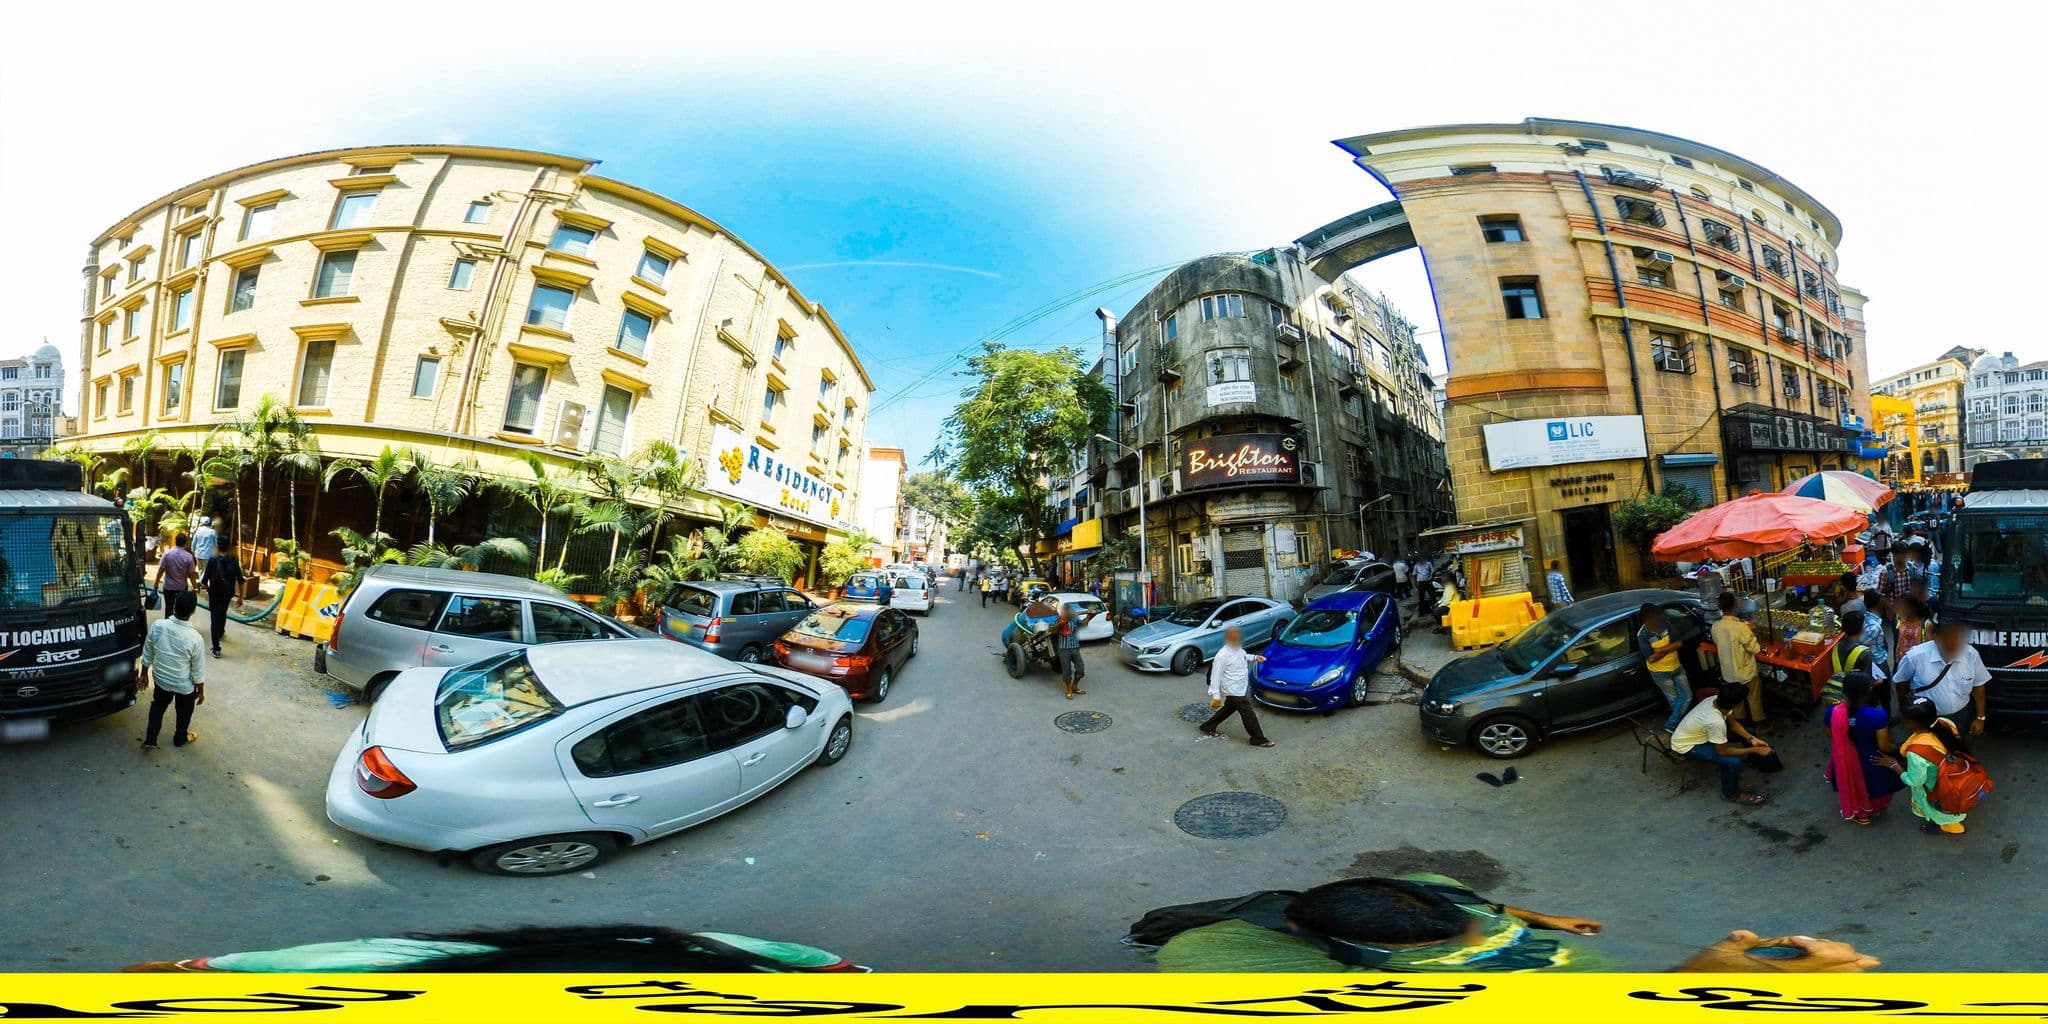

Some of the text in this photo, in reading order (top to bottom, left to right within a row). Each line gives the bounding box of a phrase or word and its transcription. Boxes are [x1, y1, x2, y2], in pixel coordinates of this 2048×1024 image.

[1570, 422, 1594, 438] LIC
[1189, 445, 1288, 477] Brighton
[748, 445, 833, 504] RESIDENCY
[1239, 467, 1293, 475] RESTAURANT
[1561, 485, 1609, 497] BUILDING
[1928, 519, 1937, 528] 10
[13, 625, 86, 647] LOCATING
[88, 619, 115, 638] VAN
[1969, 630, 2048, 648] ABLE FAUL
[36, 648, 82, 664] बेस्ट
[9, 669, 46, 680] TATA
